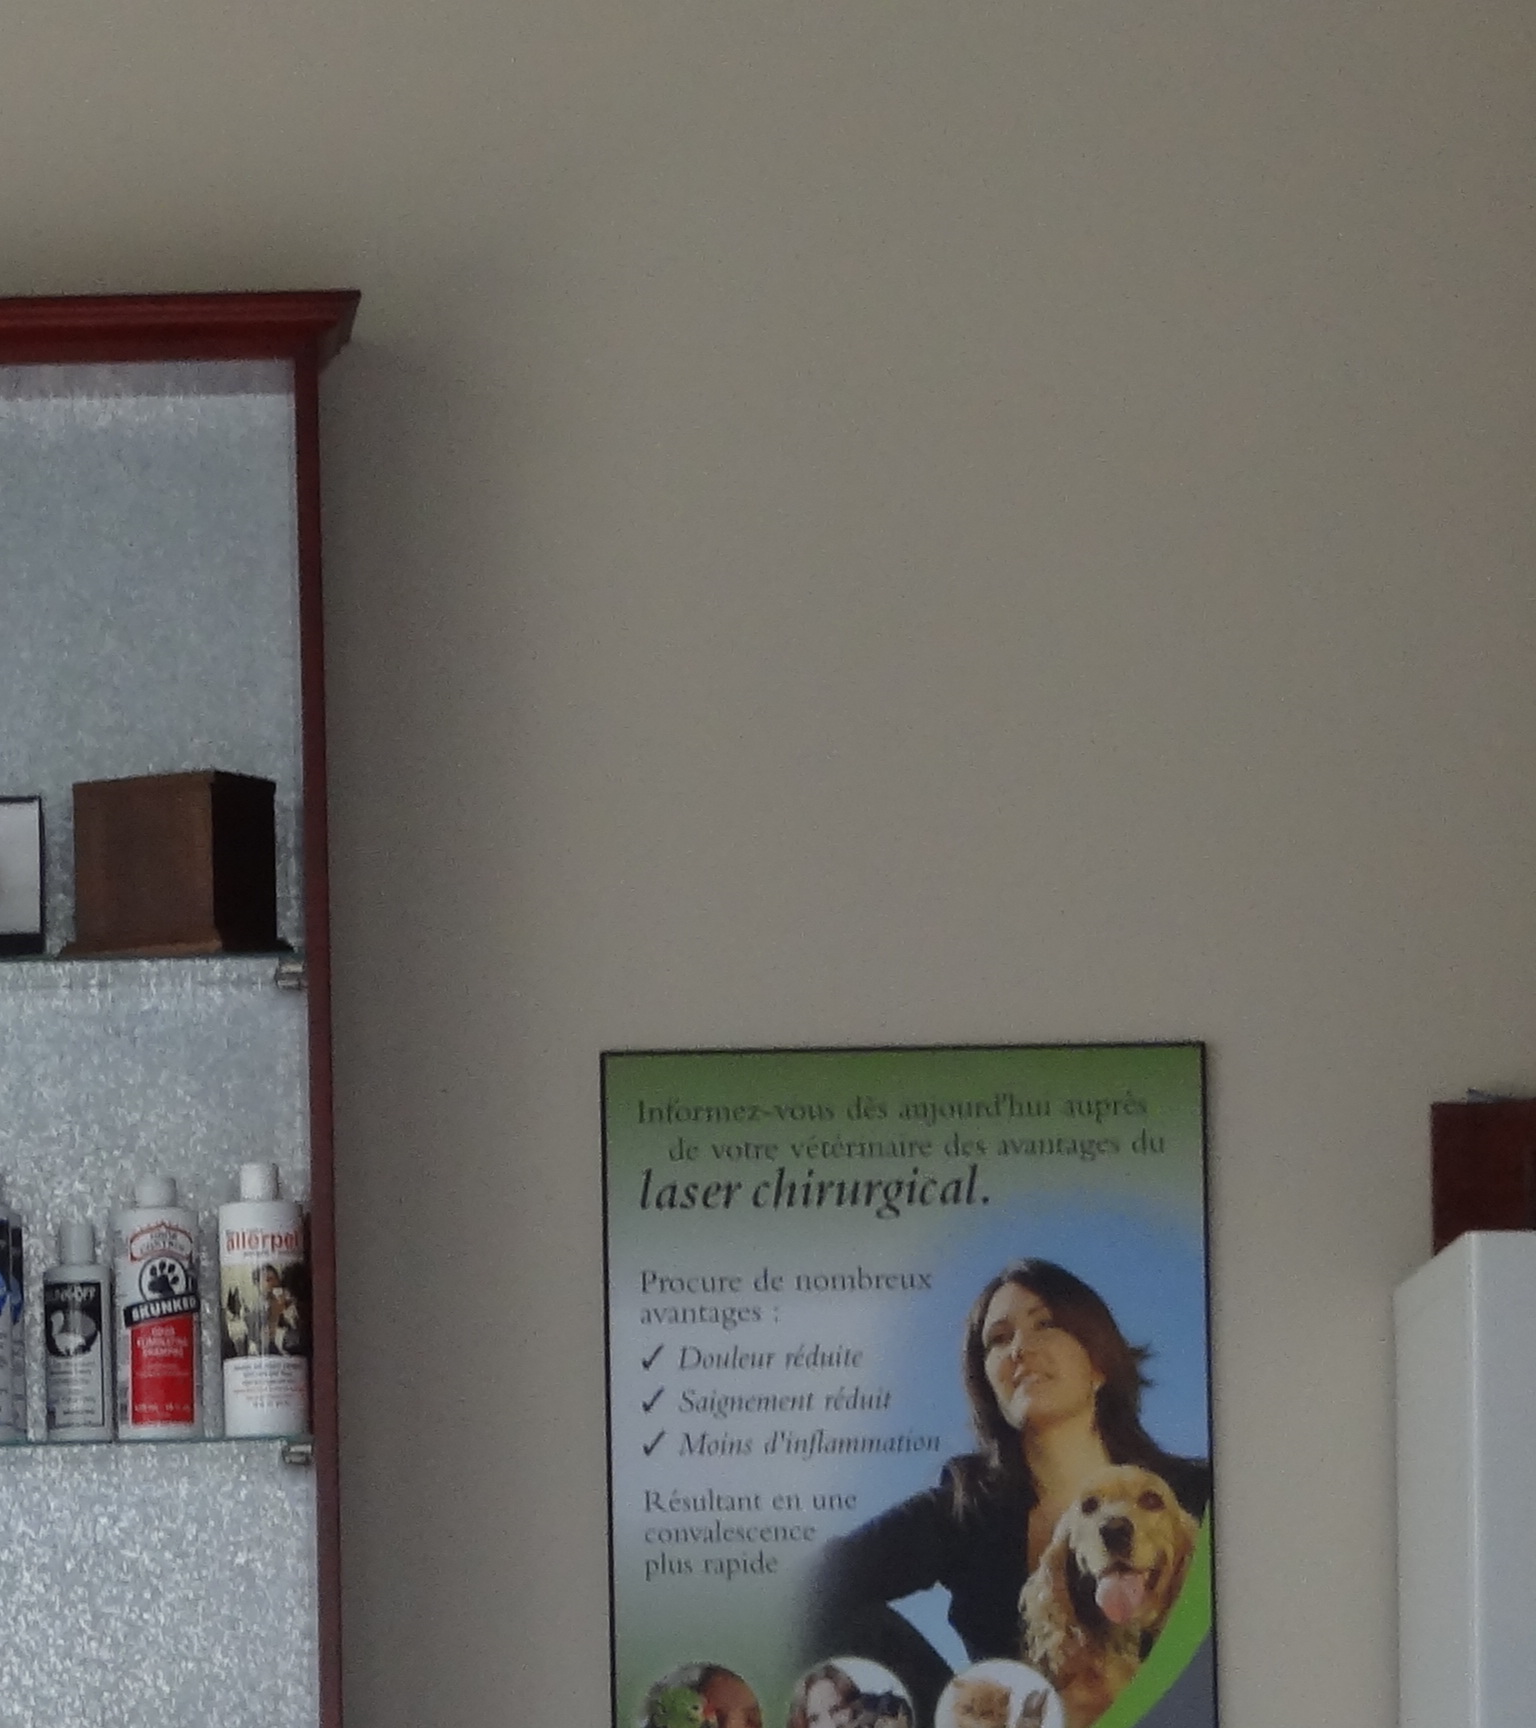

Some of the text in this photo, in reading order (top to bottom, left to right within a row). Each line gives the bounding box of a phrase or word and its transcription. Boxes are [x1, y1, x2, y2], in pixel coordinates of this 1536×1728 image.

[668, 1136, 699, 1161] de
[711, 1138, 778, 1160] votre
[944, 1132, 986, 1158] des
[997, 1134, 1120, 1161] avantages
[1132, 1129, 1166, 1156] du
[639, 1163, 992, 1220] laser chirurgical.
[640, 1266, 933, 1294] Procure de nombreux
[640, 1304, 762, 1331] avantages
[679, 1343, 864, 1371] Douleur réduite
[679, 1385, 892, 1418] Saignement réduit
[679, 1428, 942, 1459] Moins d'inflammation
[644, 1488, 858, 1513] Résultant en une
[645, 1519, 817, 1544] convalescence
[645, 1549, 778, 1581] plus rapide
